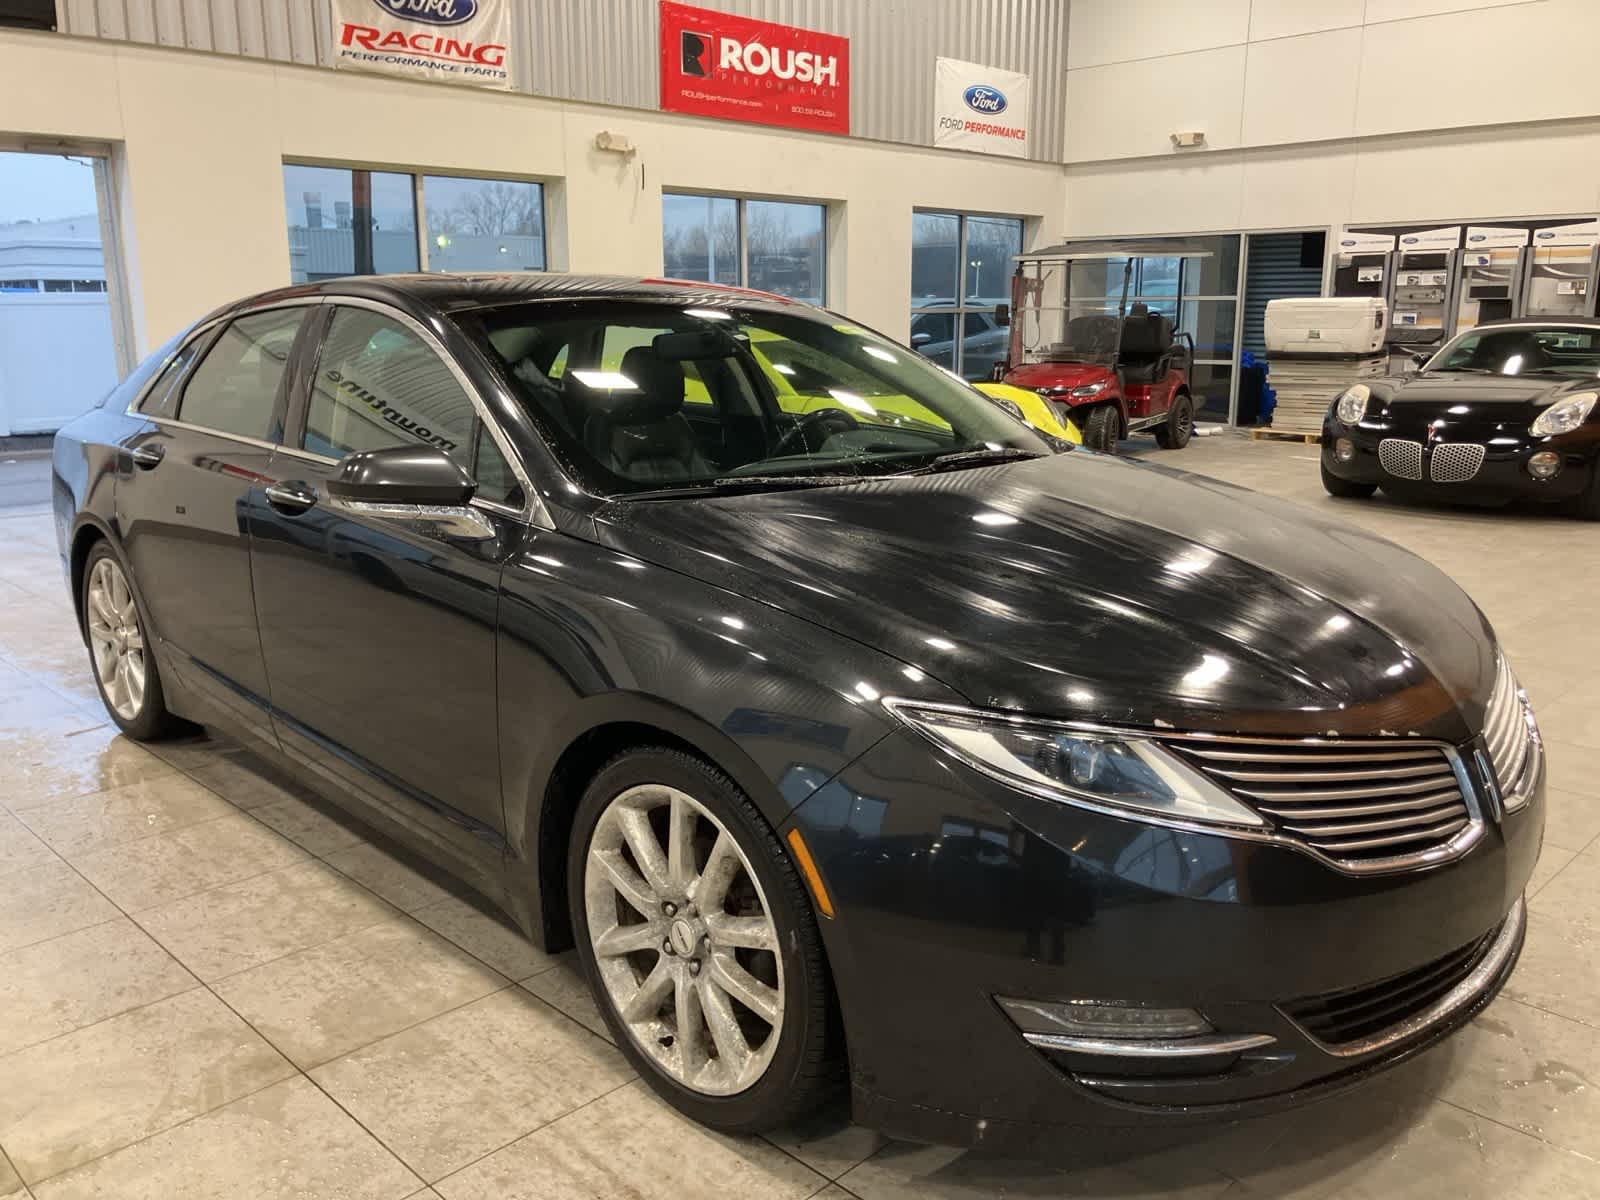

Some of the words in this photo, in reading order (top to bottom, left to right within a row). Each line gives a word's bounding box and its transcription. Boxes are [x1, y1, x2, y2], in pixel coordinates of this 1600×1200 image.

[341, 24, 506, 66] RACING
[341, 50, 459, 73] PERFORMANCE
[464, 66, 507, 79] PARTS
[720, 37, 838, 87] ROUSH
[972, 89, 1000, 111] Ford
[940, 117, 964, 130] FORD
[964, 121, 1026, 141] PERFORMANCE
